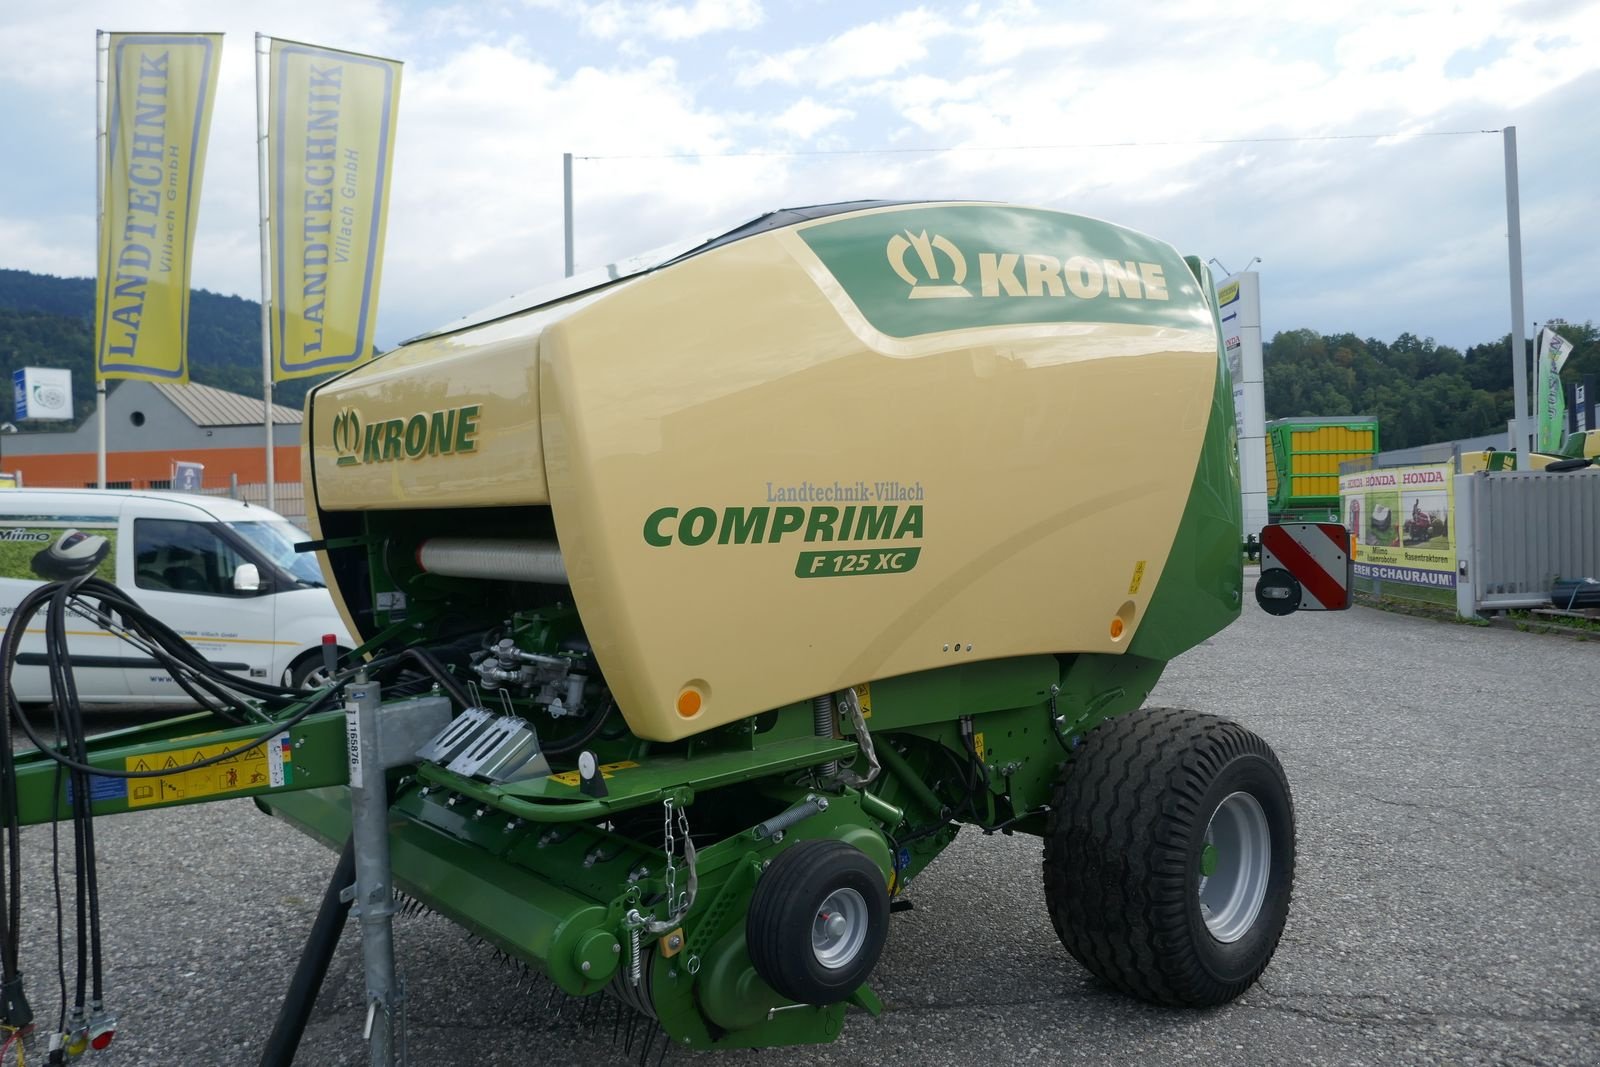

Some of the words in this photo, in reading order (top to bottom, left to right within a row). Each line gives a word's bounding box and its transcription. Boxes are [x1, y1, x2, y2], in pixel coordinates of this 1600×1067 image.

[340, 148, 360, 199] GmbH
[108, 50, 170, 358] LANDTECHNIK
[159, 210, 175, 273] Villach
[167, 144, 180, 202] GmbH
[303, 63, 344, 356] LANDTECHNIK
[334, 209, 354, 264] Villach
[978, 252, 1169, 301] KRONE
[362, 403, 482, 465] KRONE
[766, 480, 924, 502] Landtechnik-Villach
[1365, 475, 1396, 487] HONDA
[1402, 471, 1444, 484] HONDA
[0, 528, 50, 541] Miimo
[643, 504, 924, 548] COMPRIMA
[809, 556, 826, 574] F
[832, 554, 871, 573] 125
[874, 552, 906, 571] XC
[1354, 564, 1371, 577] EREN
[1372, 567, 1452, 586] SCHAURAUM!
[1404, 551, 1449, 564] Rasentraktoren
[349, 721, 359, 765] 1165876
